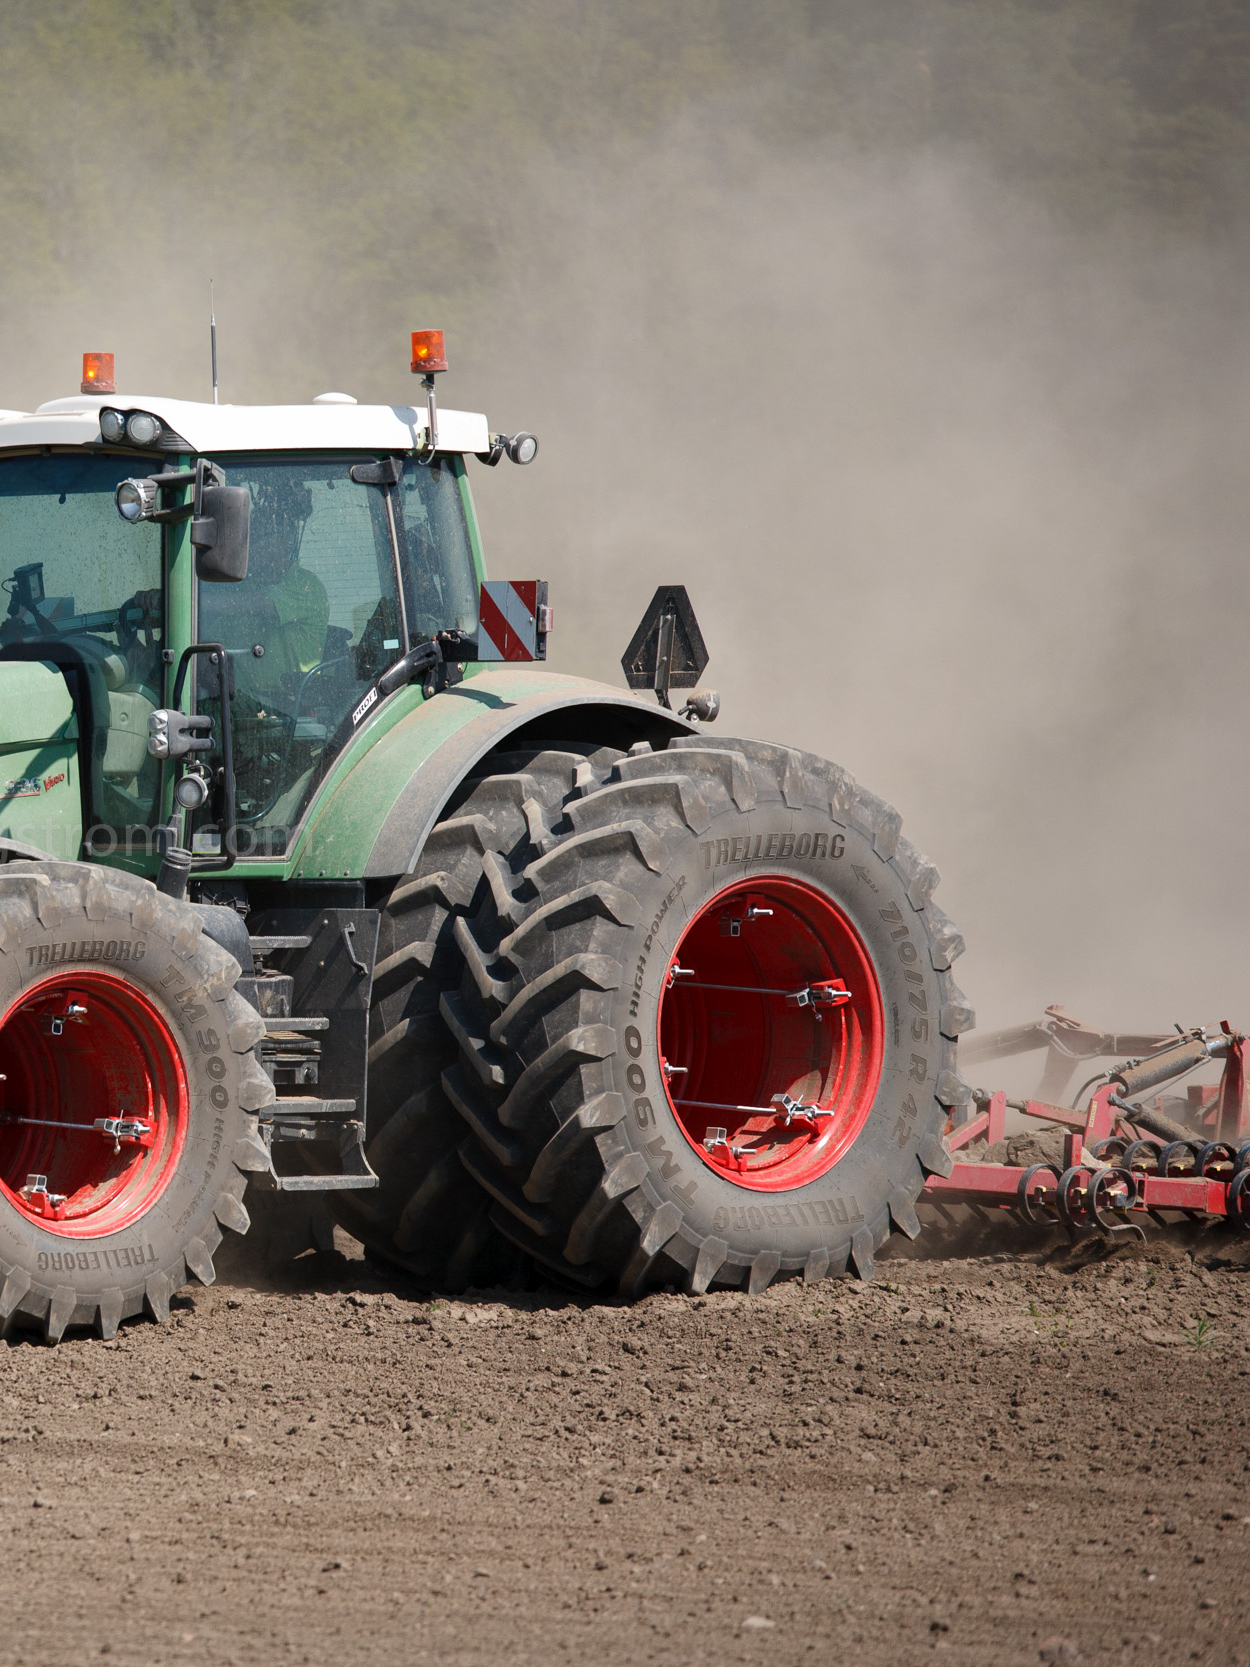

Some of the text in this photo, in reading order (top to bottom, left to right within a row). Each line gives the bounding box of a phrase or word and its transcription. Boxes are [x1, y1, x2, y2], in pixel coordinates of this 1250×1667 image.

[354, 690, 376, 721] PROFI
[5, 776, 41, 796] 936
[43, 772, 66, 793] Vario
[698, 832, 846, 869] TRELLEBORG
[25, 939, 147, 967] TRELLEBORG
[629, 955, 647, 1018] HIGH
[644, 875, 688, 954] POWER
[908, 1052, 928, 1085] R
[892, 1092, 919, 1149] 42
[207, 1117, 225, 1170] HIGH
[171, 1170, 212, 1234] POWER
[713, 1194, 867, 1233] TRELLEBORG
[37, 1242, 160, 1272] TRELLEBORG
